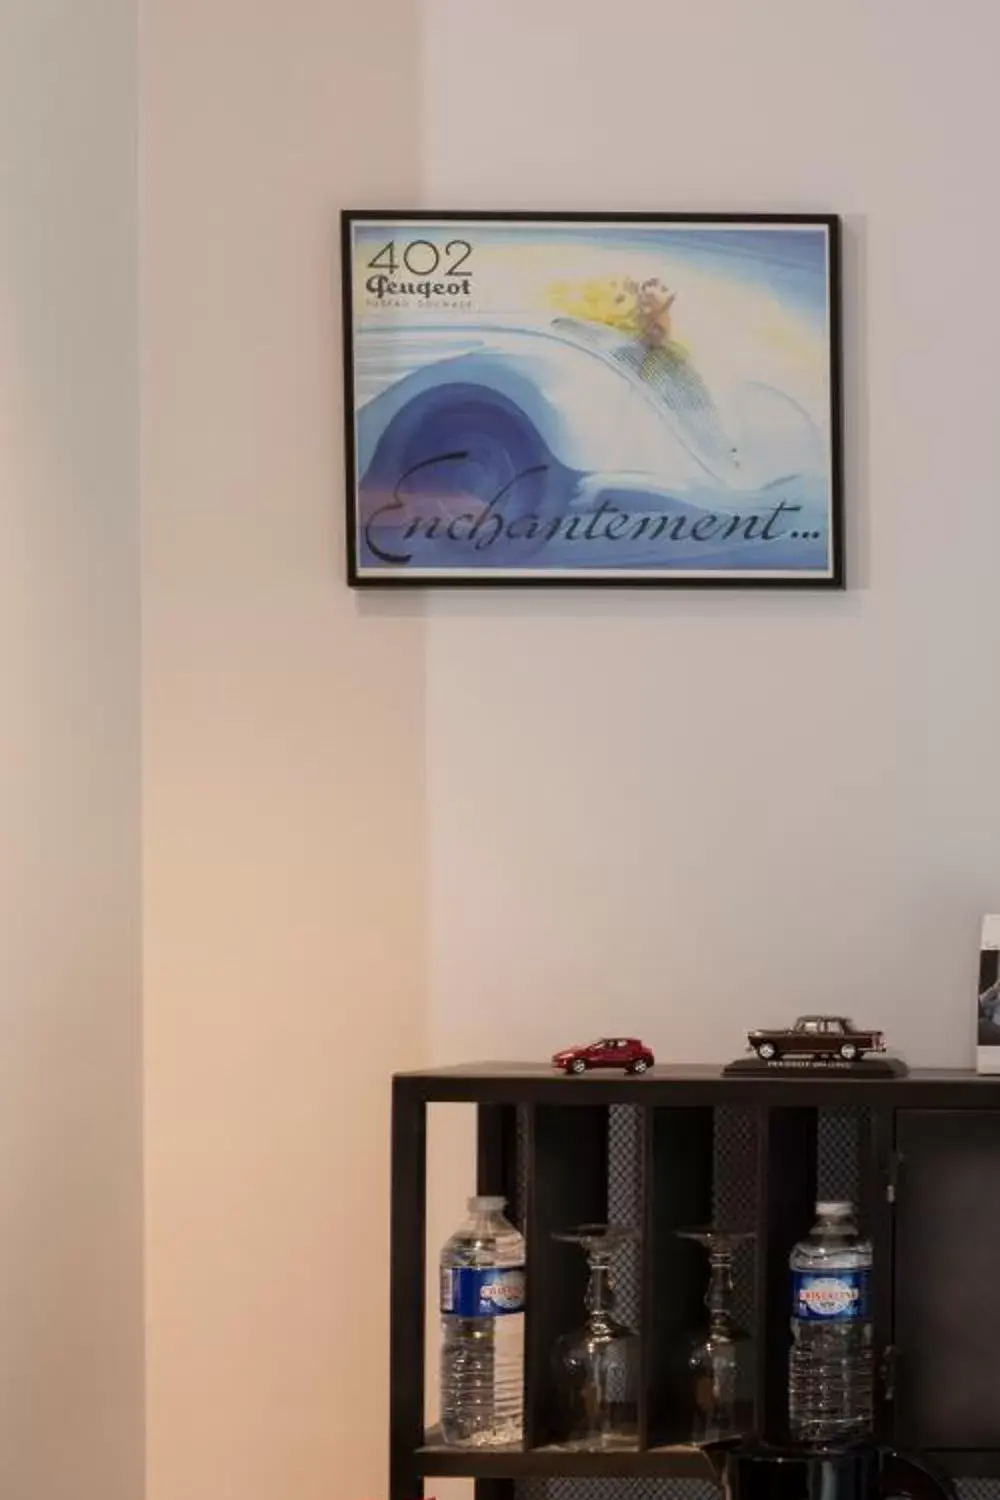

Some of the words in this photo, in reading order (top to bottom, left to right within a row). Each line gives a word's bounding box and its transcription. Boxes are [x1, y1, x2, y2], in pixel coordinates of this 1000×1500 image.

[367, 239, 473, 277] 402
[365, 273, 472, 299] Peugeot
[365, 451, 820, 564] Enchantement...
